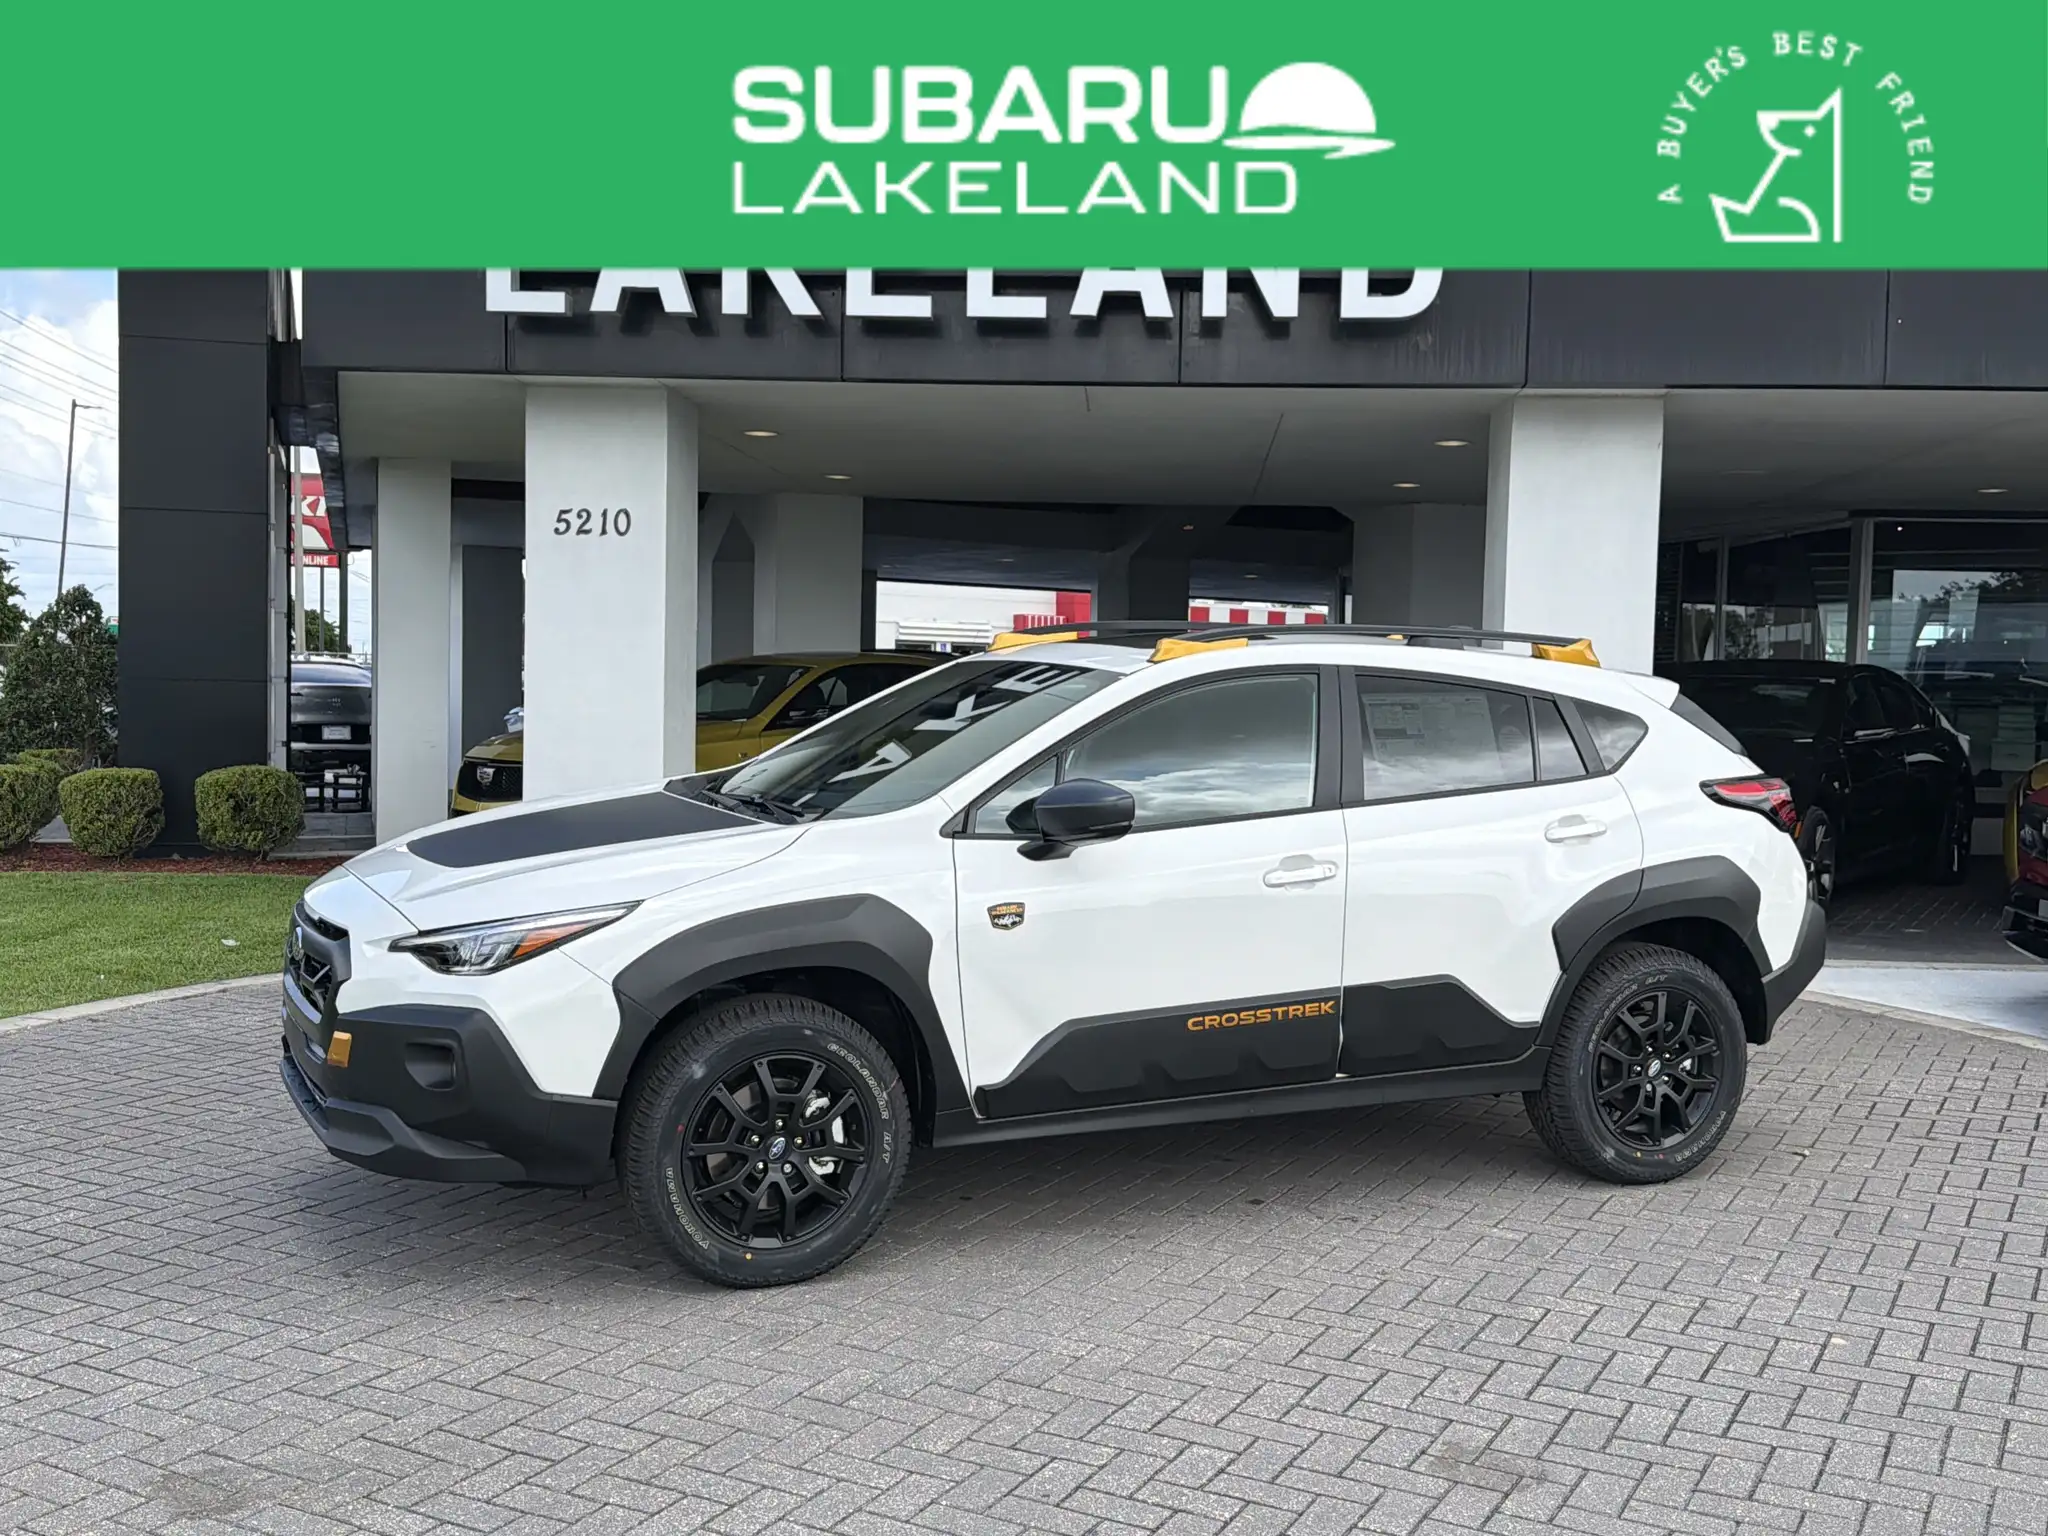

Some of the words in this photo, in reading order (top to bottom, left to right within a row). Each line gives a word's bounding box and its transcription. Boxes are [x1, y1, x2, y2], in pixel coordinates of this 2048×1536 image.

[553, 507, 632, 537] 5210
[1186, 1000, 1336, 1032] CROSSTREK
[827, 1042, 890, 1120] GEOLANDAR
[665, 1167, 710, 1250] YOKOHAMA
